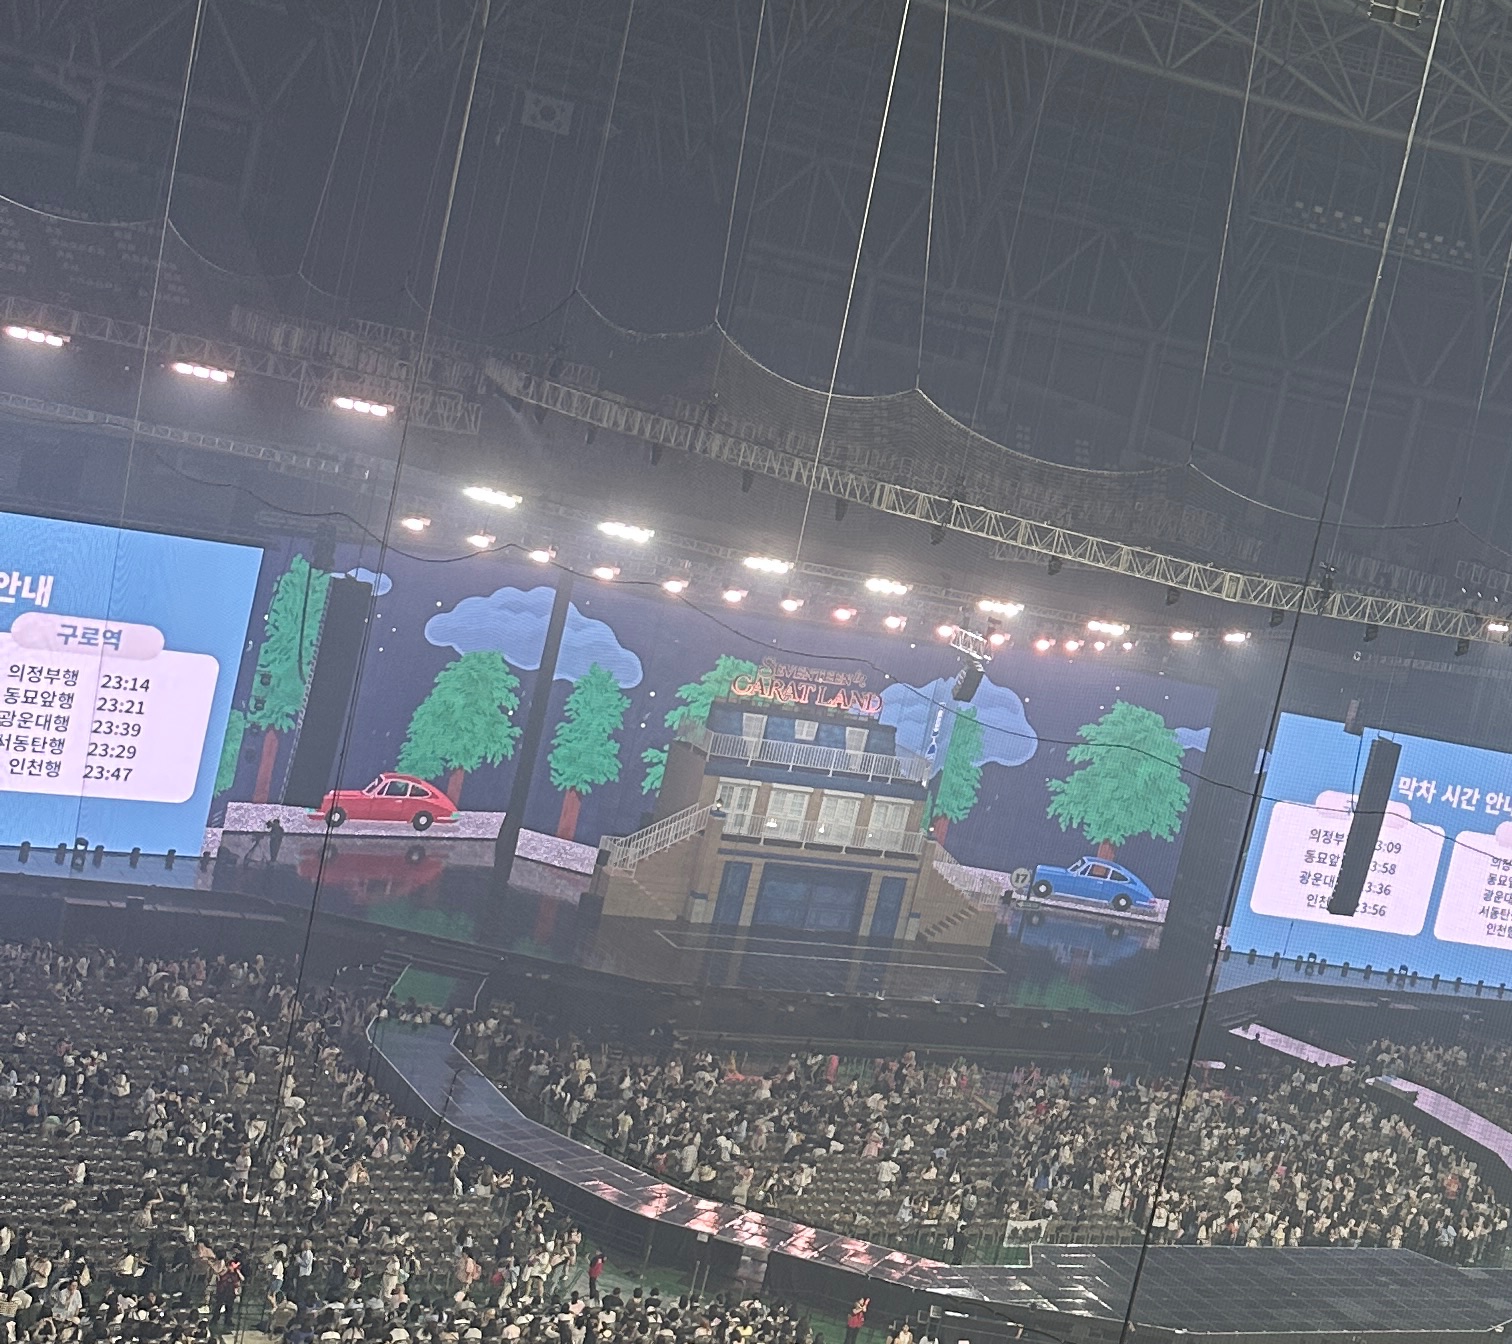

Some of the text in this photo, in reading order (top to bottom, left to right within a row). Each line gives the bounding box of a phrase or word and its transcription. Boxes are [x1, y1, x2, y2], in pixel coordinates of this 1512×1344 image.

[0, 570, 55, 608] 안내
[57, 623, 122, 651] 구로역
[7, 664, 150, 692] 의정부행 23:14
[3, 687, 145, 715] 동묘앞행 23:21
[731, 674, 883, 714] CARAT LAND
[0, 709, 141, 737] 광운대행 23:39
[87, 743, 137, 760] 23:29
[9, 758, 133, 782] 인천행 23:47
[1398, 776, 1436, 804] 막차
[1441, 784, 1480, 812] 시간
[1308, 827, 1402, 855] 의정부 3:09
[1303, 850, 1397, 875] 동묘앞 3:58
[1298, 870, 1392, 897] 광운대 3:36
[1306, 894, 1330, 910] 인천
